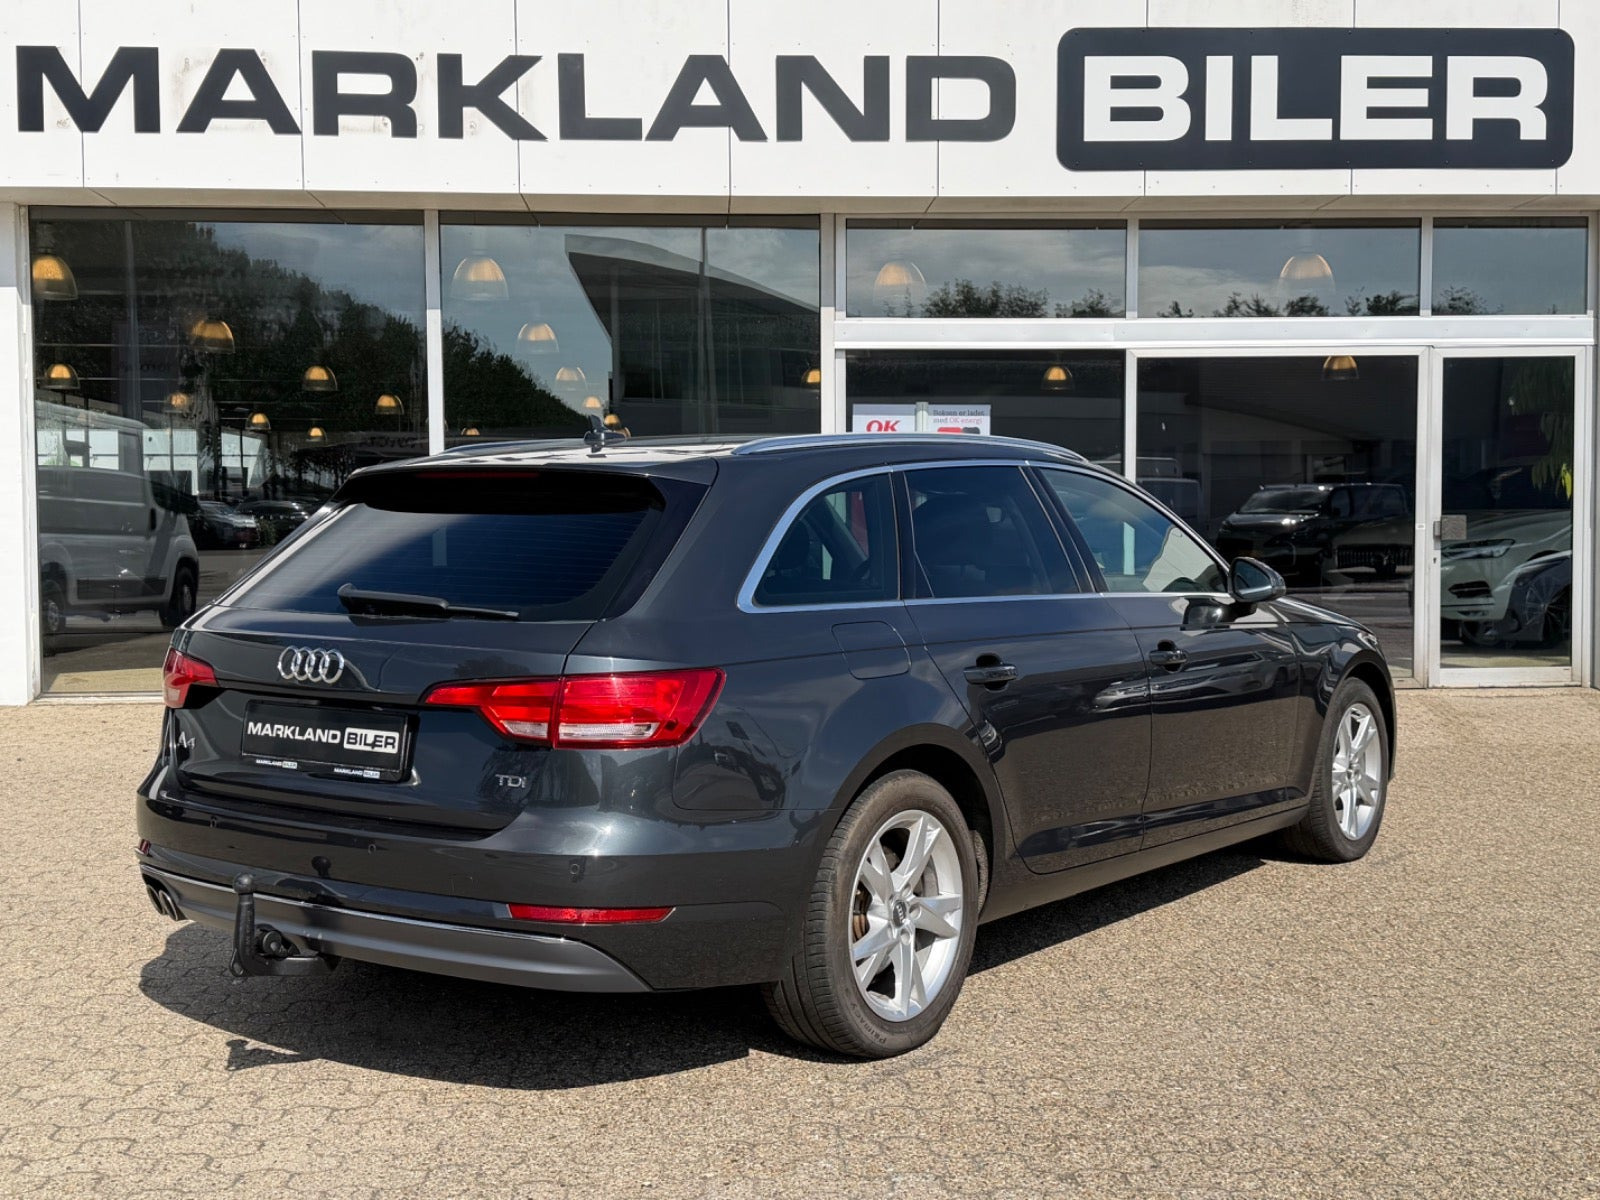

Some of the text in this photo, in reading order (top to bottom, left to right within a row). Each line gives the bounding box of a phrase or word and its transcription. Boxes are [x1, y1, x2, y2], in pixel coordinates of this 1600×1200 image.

[17, 46, 1548, 142] MARKLAND BILER
[866, 420, 900, 432] OK
[247, 721, 397, 749] MARKLAND BILER
[256, 759, 282, 767] MARKLAND
[334, 767, 363, 775] MARKLAND
